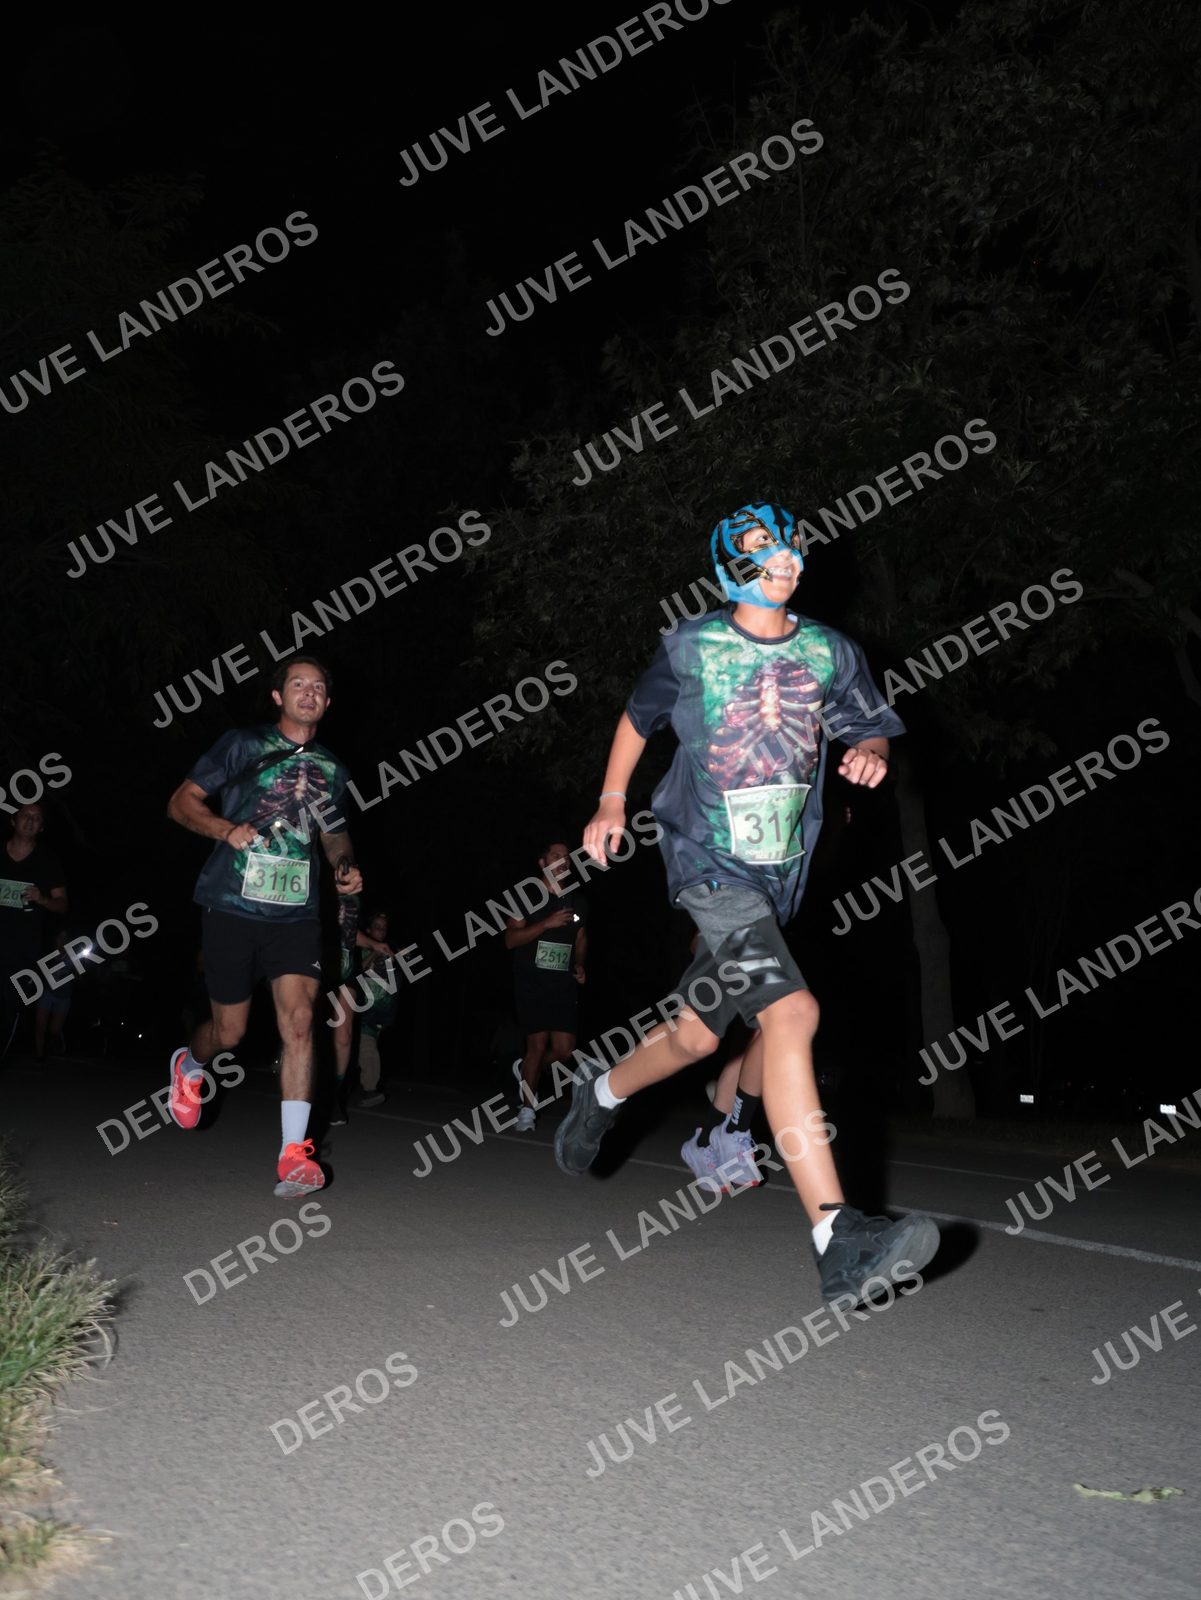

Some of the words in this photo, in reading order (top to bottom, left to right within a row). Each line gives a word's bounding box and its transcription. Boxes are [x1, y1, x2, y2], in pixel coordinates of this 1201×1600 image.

[744, 810, 801, 845] 311
[252, 868, 302, 893] 3116
[541, 950, 568, 963] 2512
